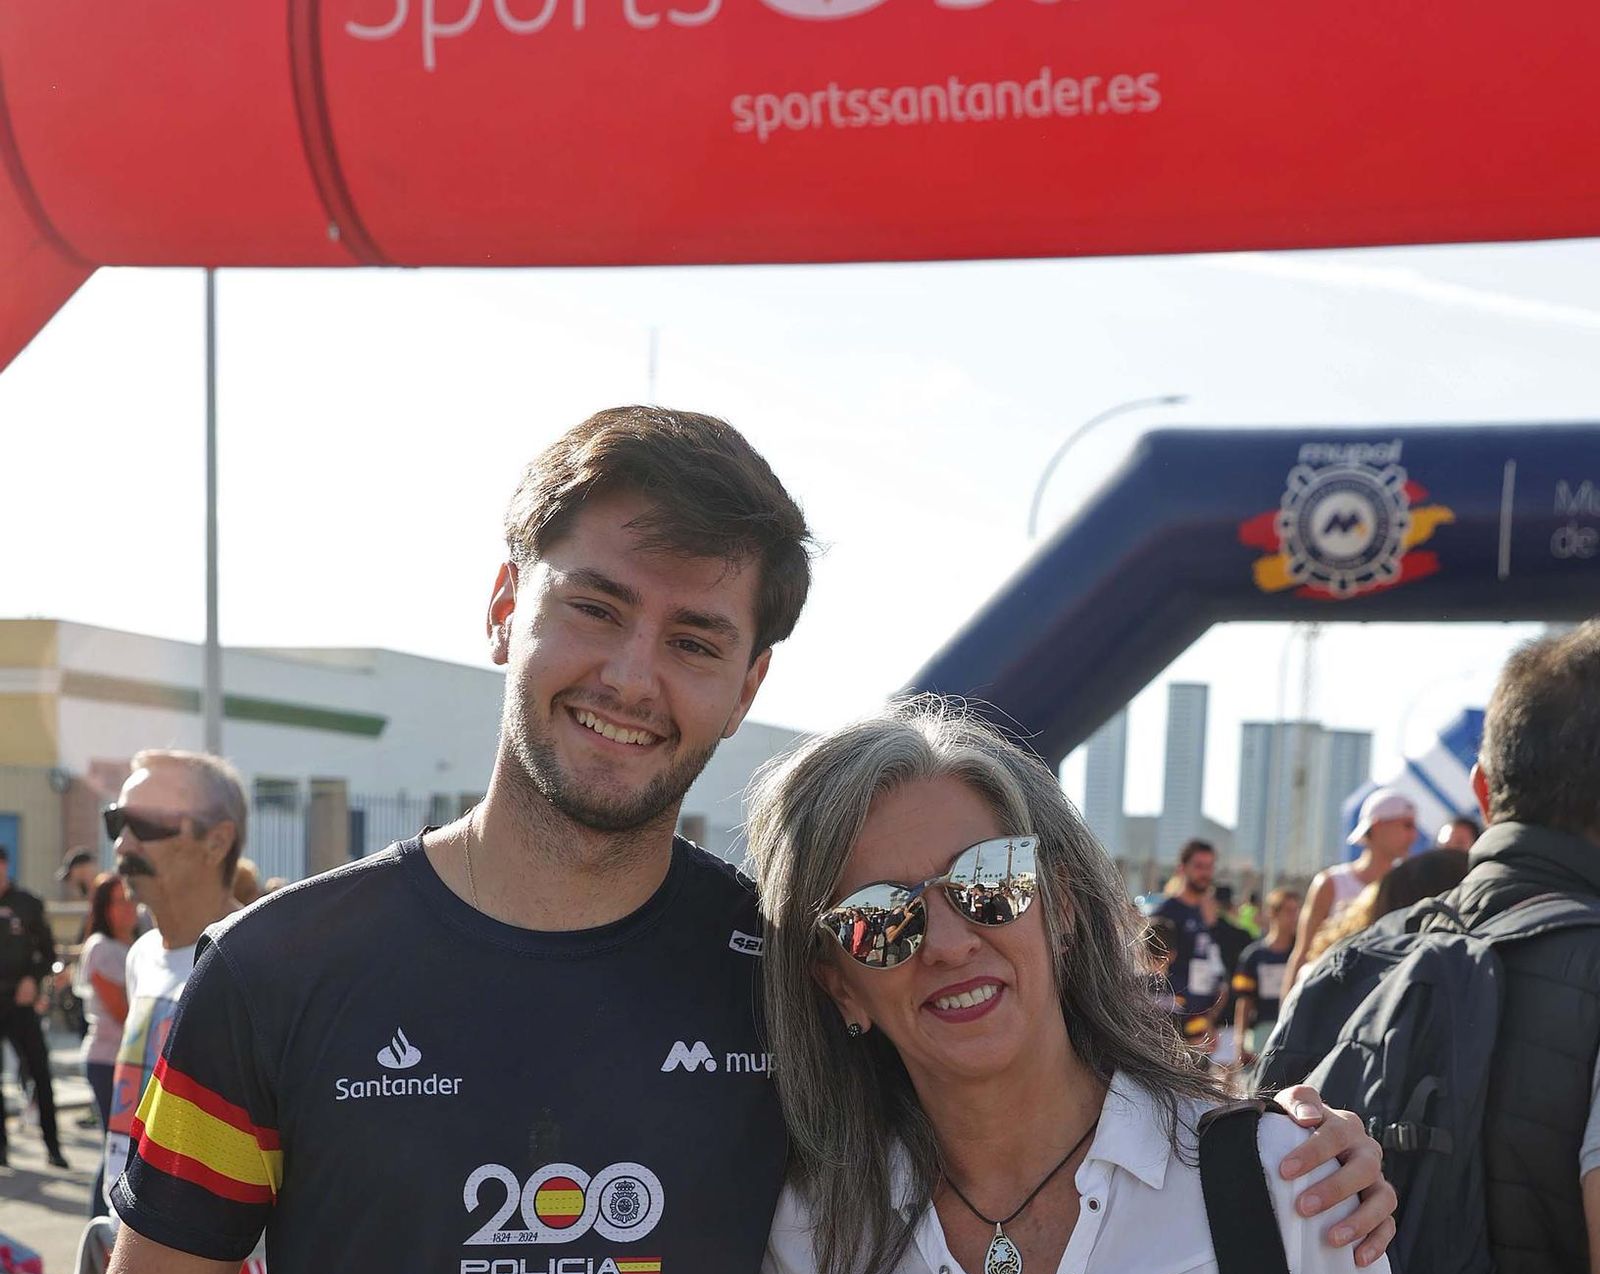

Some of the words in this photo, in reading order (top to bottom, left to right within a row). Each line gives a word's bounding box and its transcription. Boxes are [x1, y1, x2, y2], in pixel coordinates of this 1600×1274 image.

[730, 68, 1161, 141] sportssantander.es
[335, 1073, 463, 1100] Santander
[726, 1052, 778, 1079] mup
[462, 1162, 665, 1245] 200
